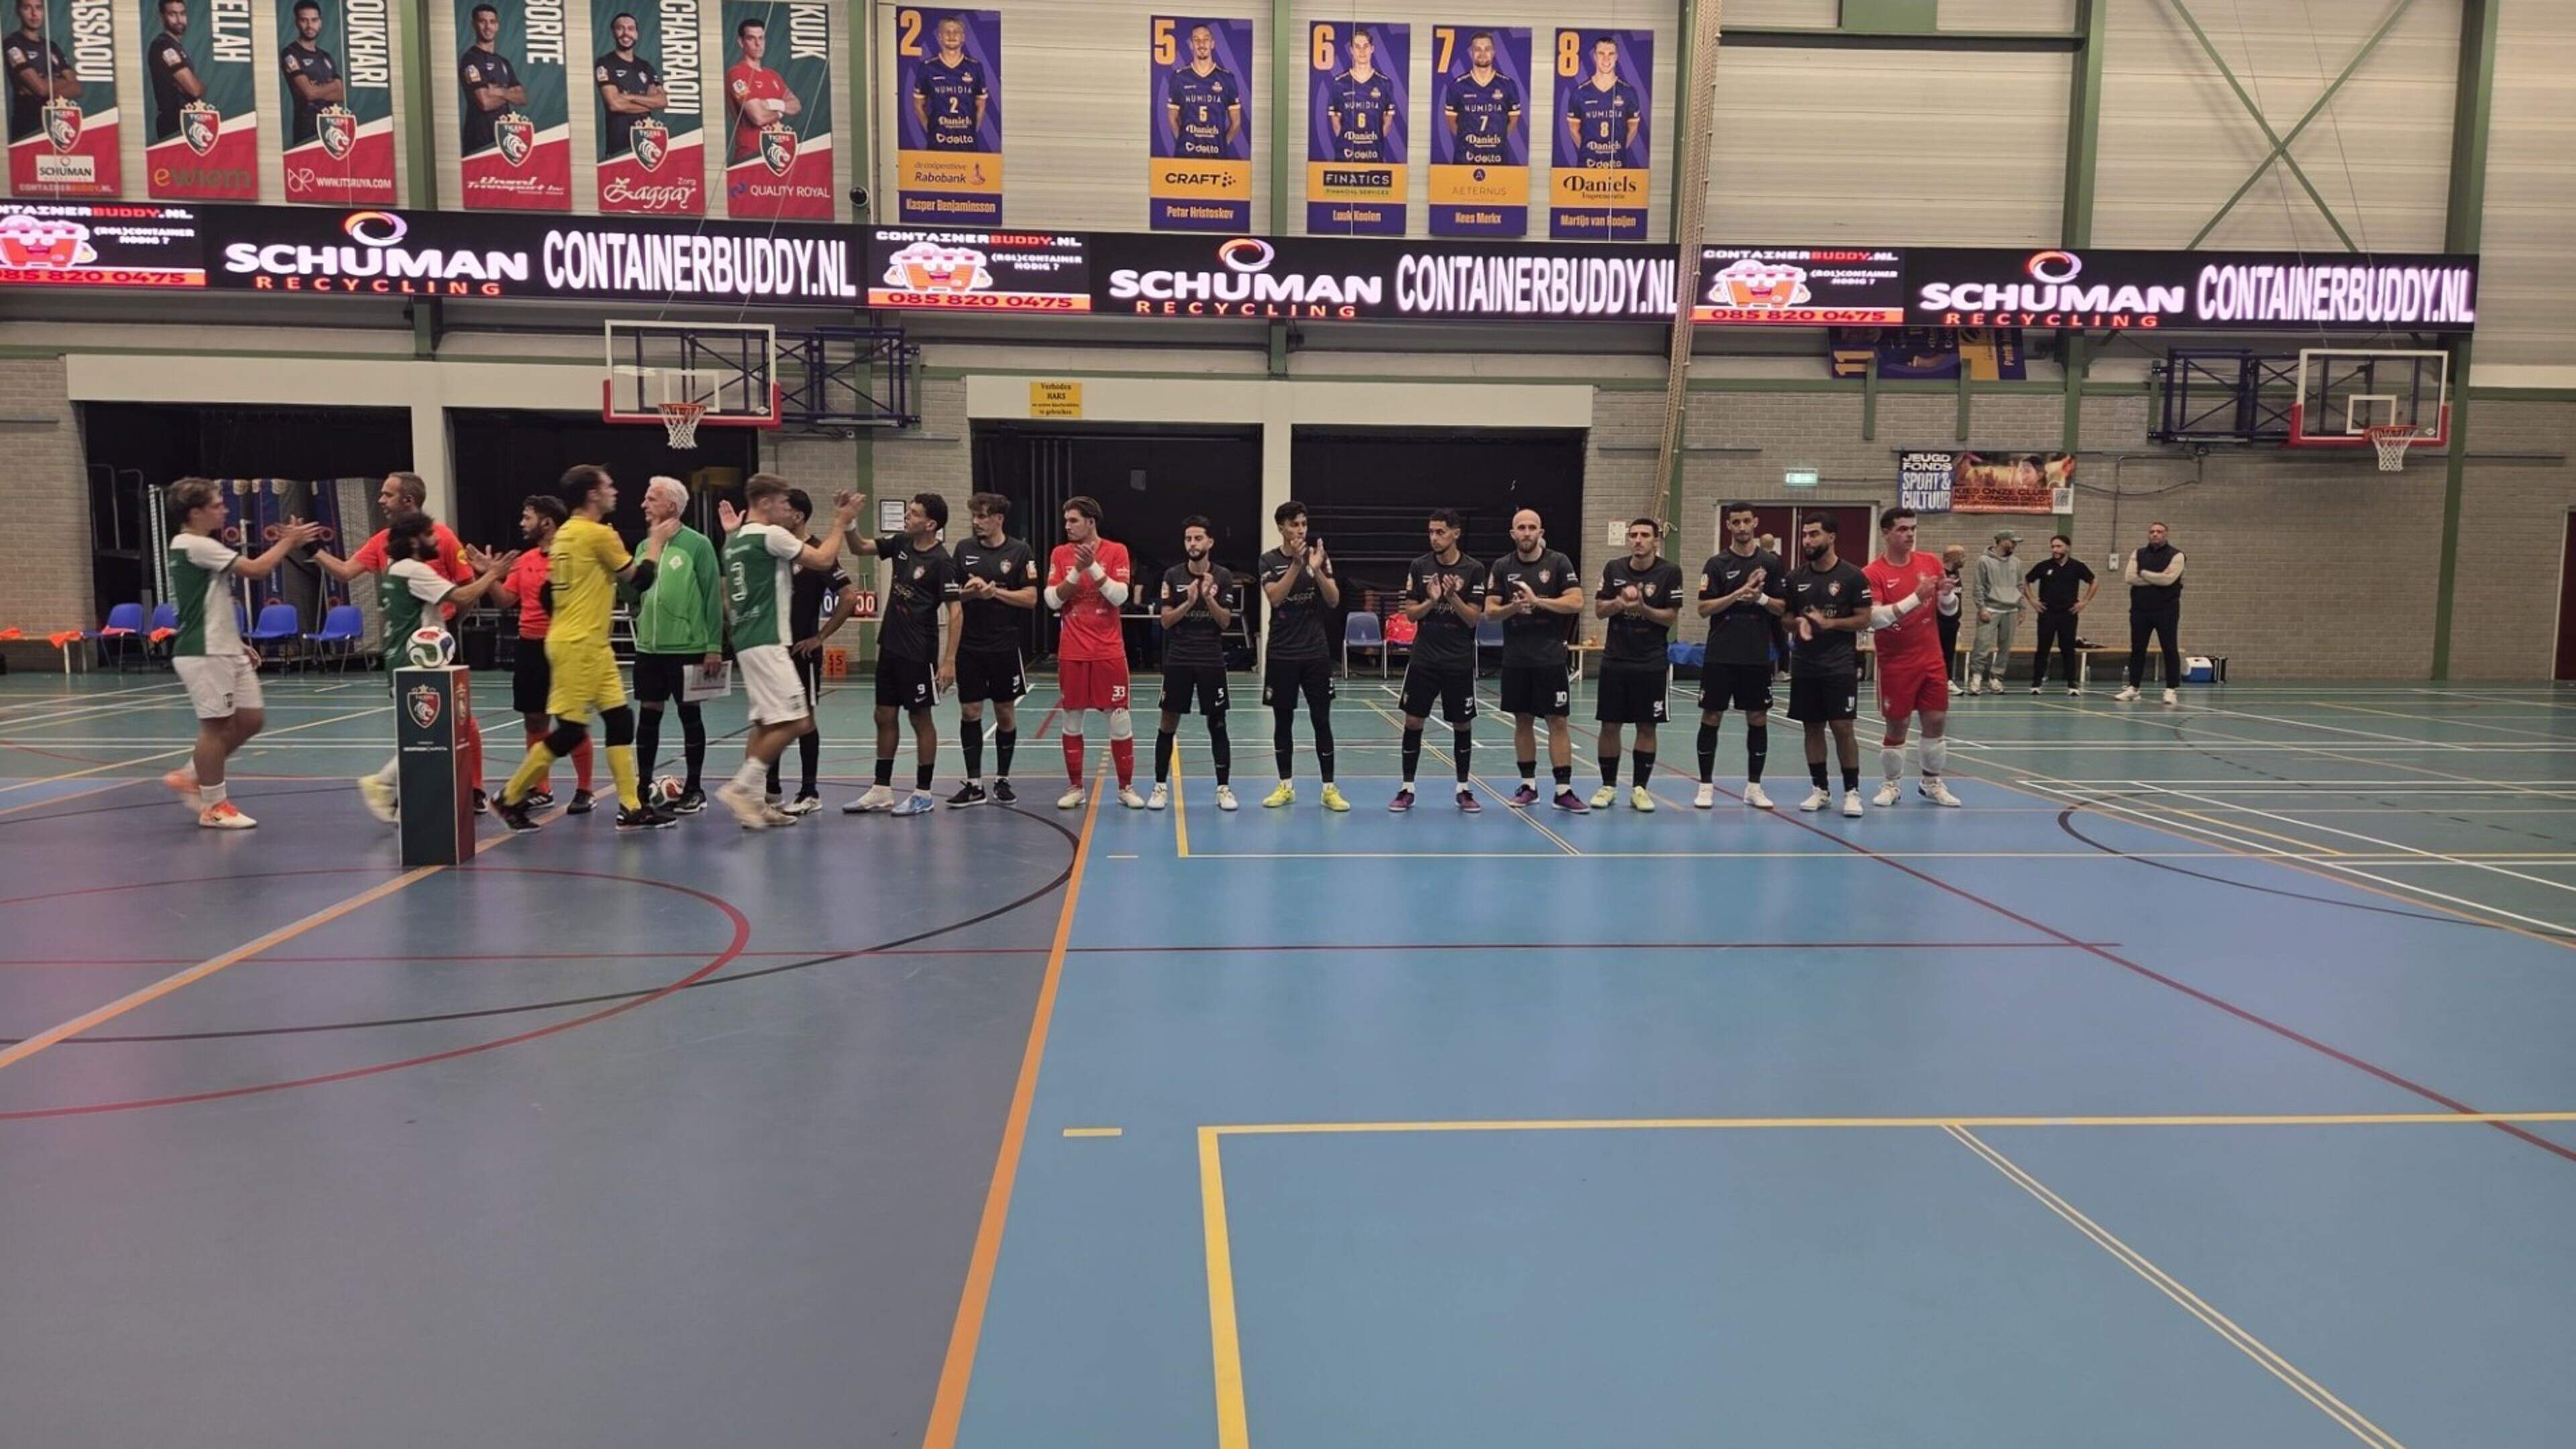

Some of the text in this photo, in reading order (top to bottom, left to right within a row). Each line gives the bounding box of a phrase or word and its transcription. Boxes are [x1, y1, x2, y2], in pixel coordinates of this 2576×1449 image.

[790, 3, 826, 60] KUIJK
[900, 10, 922, 56] 2
[347, 0, 388, 87] OUKHARI
[1154, 19, 1176, 64] 5
[1313, 25, 1335, 70] 6
[659, 0, 700, 113] CHARRAOUI
[1436, 29, 1456, 73] 7
[1558, 32, 1580, 77] 8
[934, 86, 972, 94] NUMIDIA
[949, 97, 959, 113] 2
[1185, 95, 1221, 103] NUMIDIA
[1199, 106, 1208, 121] 5
[1464, 104, 1502, 112] NUMIDIA
[1479, 115, 1489, 131] 7
[1600, 121, 1609, 138] 8
[39, 167, 92, 176] SCHUMAN
[914, 172, 967, 183] Rabobank
[1165, 172, 1221, 185] CRAFT
[1326, 174, 1390, 185] FINATICS
[750, 185, 831, 198] QUALITY ROYAL
[1562, 175, 1637, 192] Daniels
[875, 231, 1082, 247] CONTAINERBUDDY.NL
[225, 242, 529, 281] SCHUMAN
[543, 230, 857, 297] CONTAINERBUDDY.NL
[1703, 250, 1898, 261] CONTAINERBUDDY.NL
[0, 270, 186, 283] 85 820 0475
[1396, 254, 1677, 314] CONTAINERBUDDY.NL
[256, 276, 500, 295] RECYCLING
[1109, 269, 1383, 304] SCHUMAN
[2197, 264, 2475, 323] CONTAINERBUDDY.NL
[888, 293, 1073, 307] 085 820 0475
[1919, 282, 2186, 313] SCHUMAN
[1136, 301, 1356, 317] RECYCLING
[1711, 309, 1886, 321] 085 820 0475
[1945, 313, 2158, 327] RECYCLING
[1902, 453, 1951, 462] JEUGD
[1902, 462, 1953, 472] FONDS
[1902, 472, 1951, 490] SPORT &
[1902, 491, 1950, 510] CULTUUR
[916, 684, 926, 694] 9
[1112, 685, 1126, 698] 33
[1218, 688, 1224, 698] 5
[1556, 691, 1568, 703] 10
